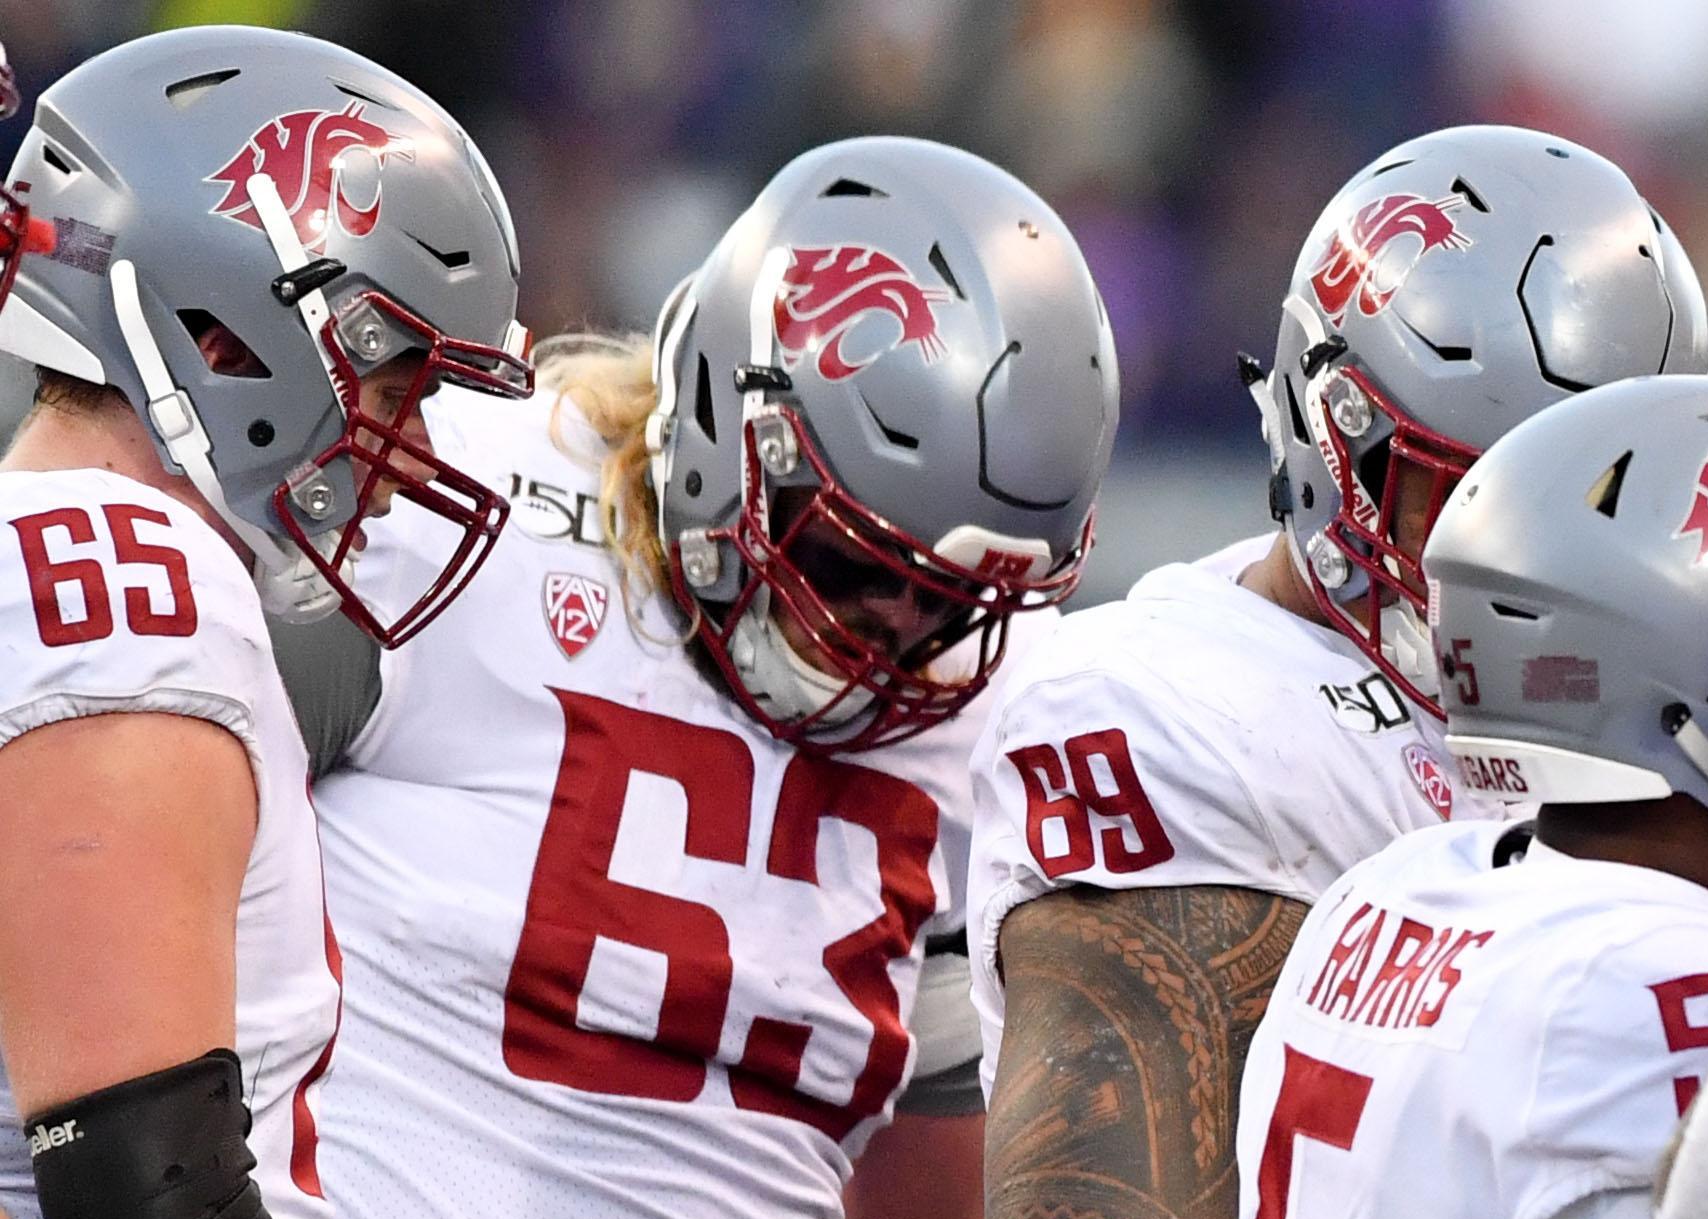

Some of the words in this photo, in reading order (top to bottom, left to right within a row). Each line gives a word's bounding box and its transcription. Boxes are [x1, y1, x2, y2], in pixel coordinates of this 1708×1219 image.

[9, 503, 198, 648] 65
[557, 607, 589, 644] 12
[1319, 672, 1411, 733] 150
[1452, 638, 1481, 706] 5
[1005, 727, 1175, 881] 69
[502, 685, 938, 1142] 63
[1306, 902, 1496, 1029] HARRIS
